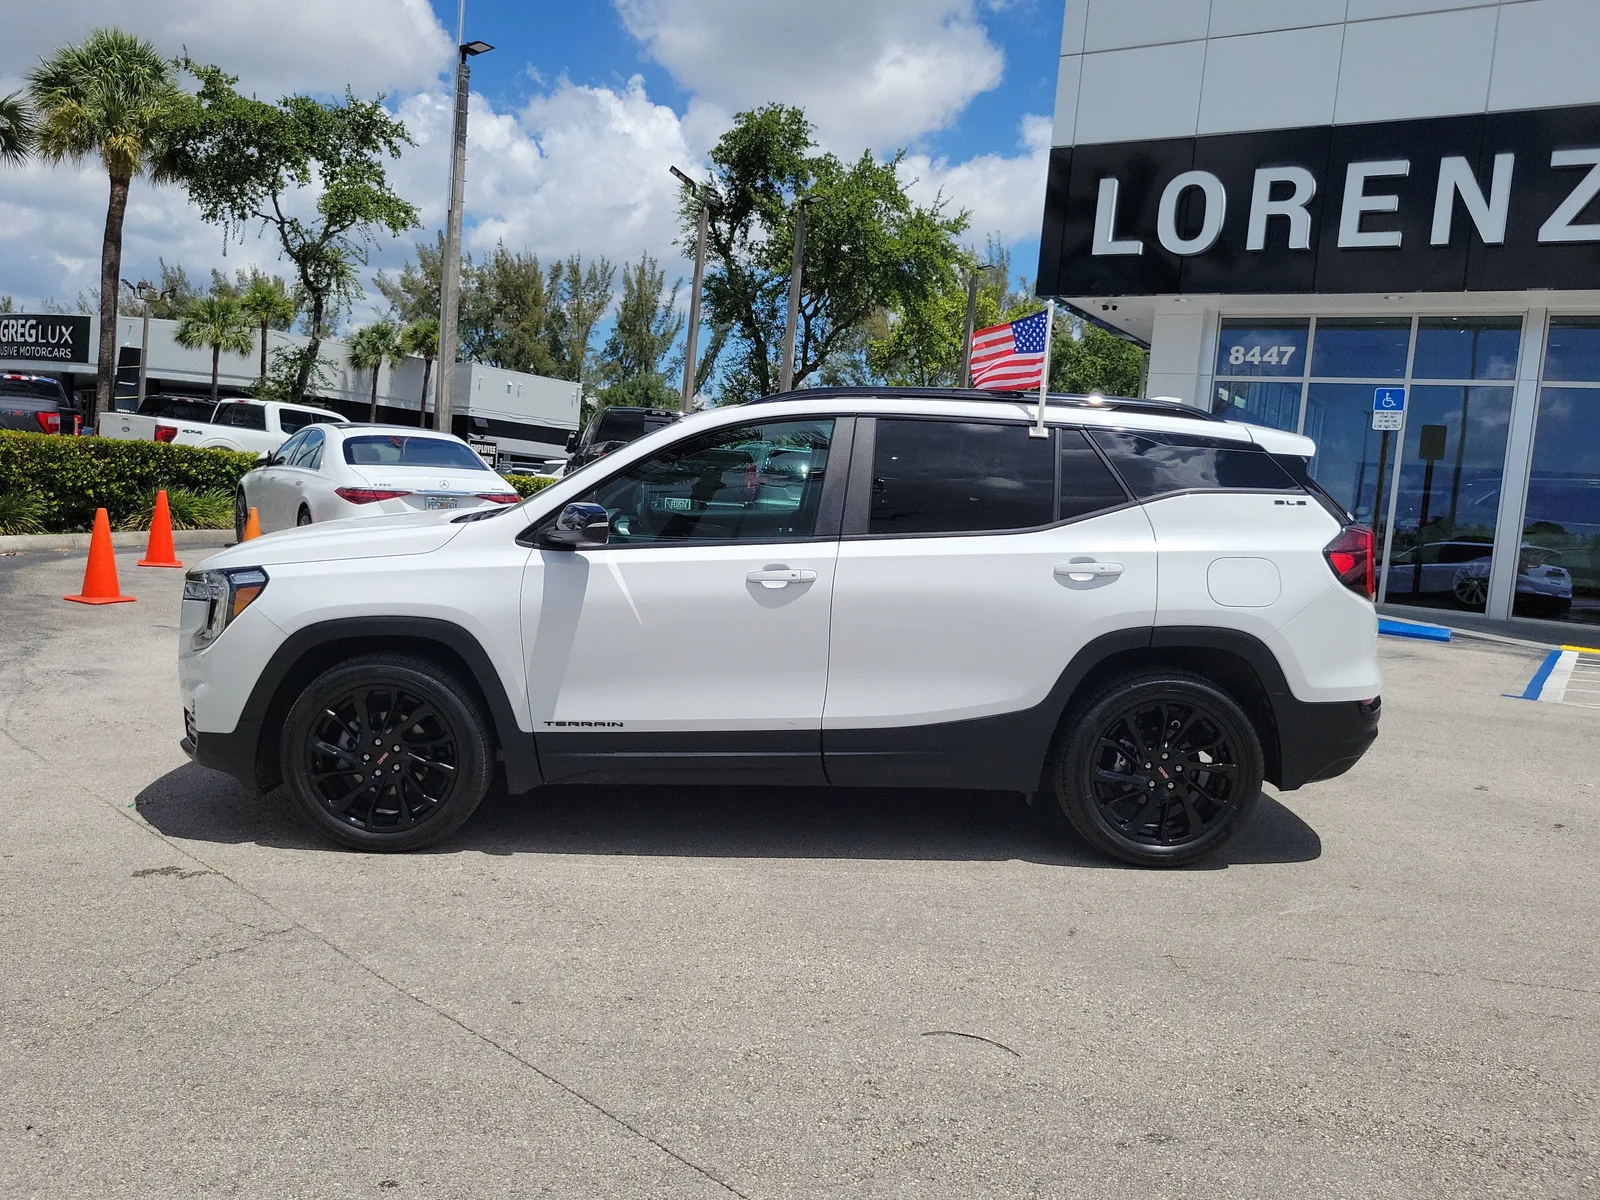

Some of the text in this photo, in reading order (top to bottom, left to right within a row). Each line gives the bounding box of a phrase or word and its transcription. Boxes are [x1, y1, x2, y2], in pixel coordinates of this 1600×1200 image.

[1091, 148, 1600, 256] LORENZ
[19, 346, 72, 359] MOTORCARS
[1229, 345, 1296, 365] 8447
